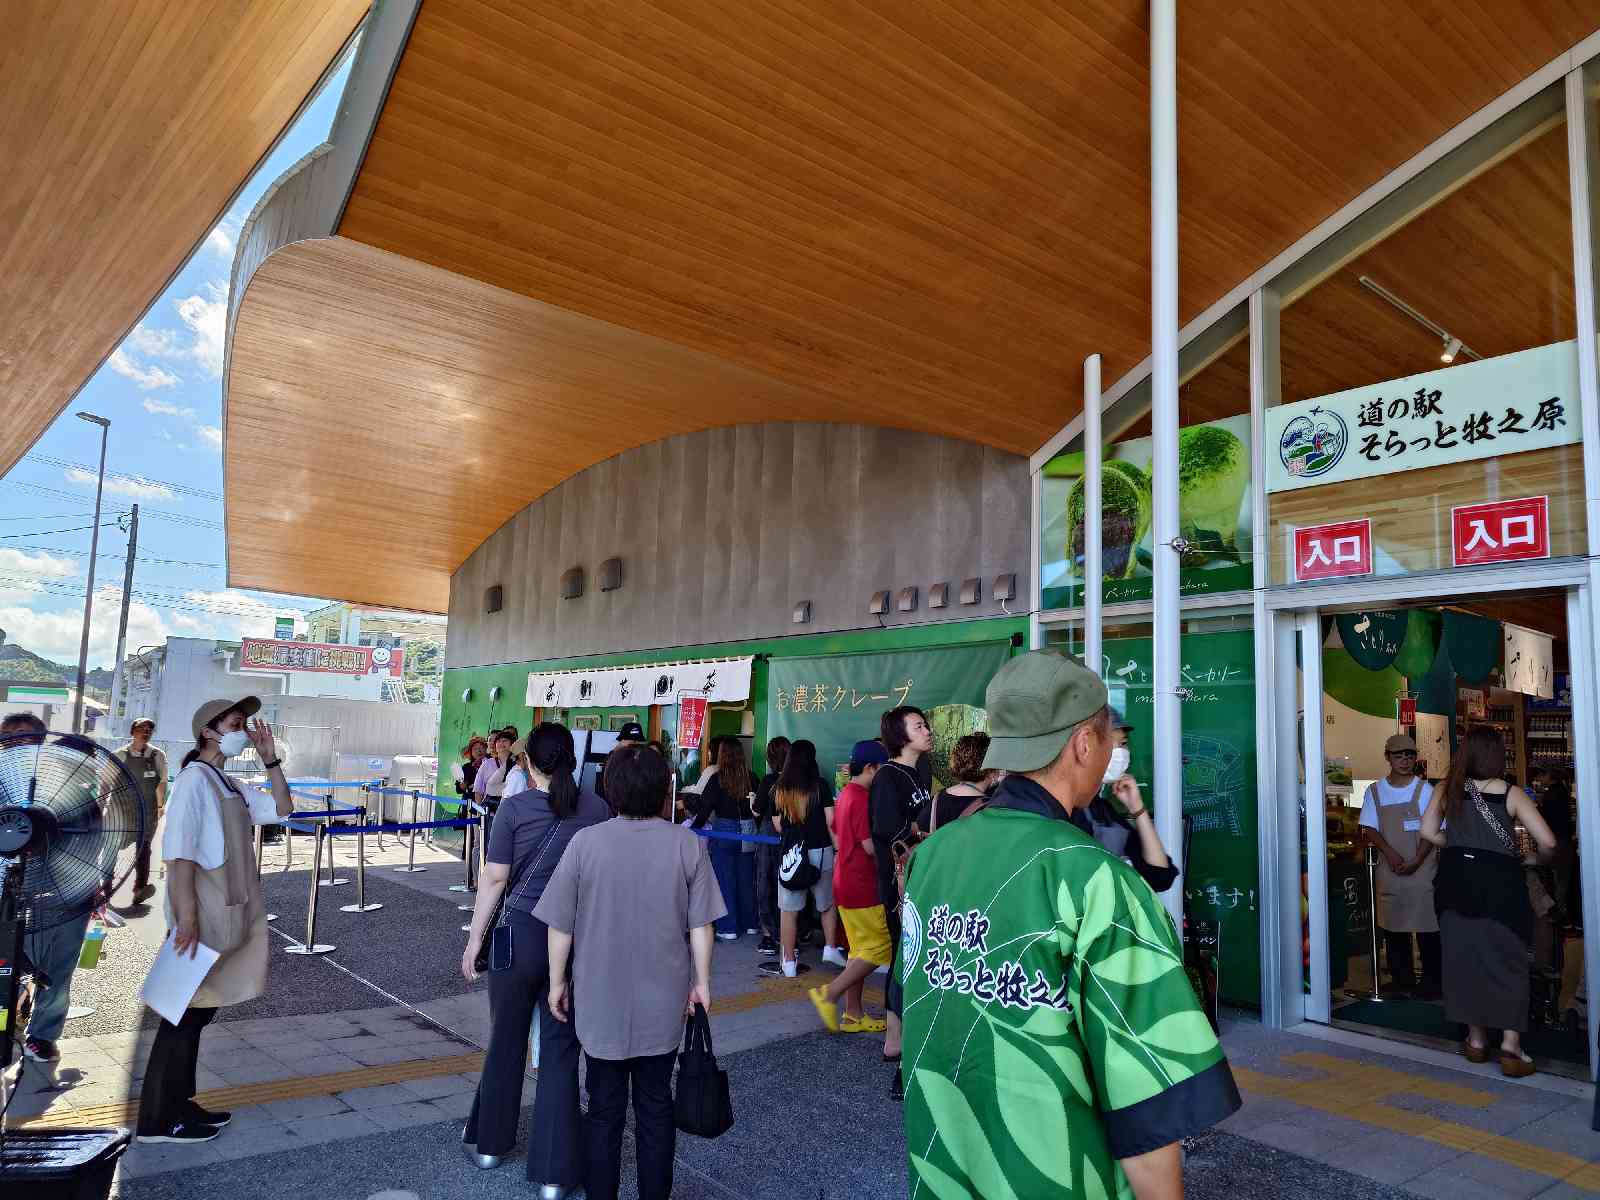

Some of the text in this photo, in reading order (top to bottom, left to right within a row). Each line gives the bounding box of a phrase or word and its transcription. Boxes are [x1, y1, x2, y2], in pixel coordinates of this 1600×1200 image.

[1357, 388, 1443, 428] 道の駅
[1358, 397, 1567, 462] そらっと牧之原
[1303, 535, 1361, 569] 入口
[1463, 514, 1535, 552] 入口
[776, 679, 913, 713] お濃茶クレープ
[928, 904, 990, 955] 道の駅
